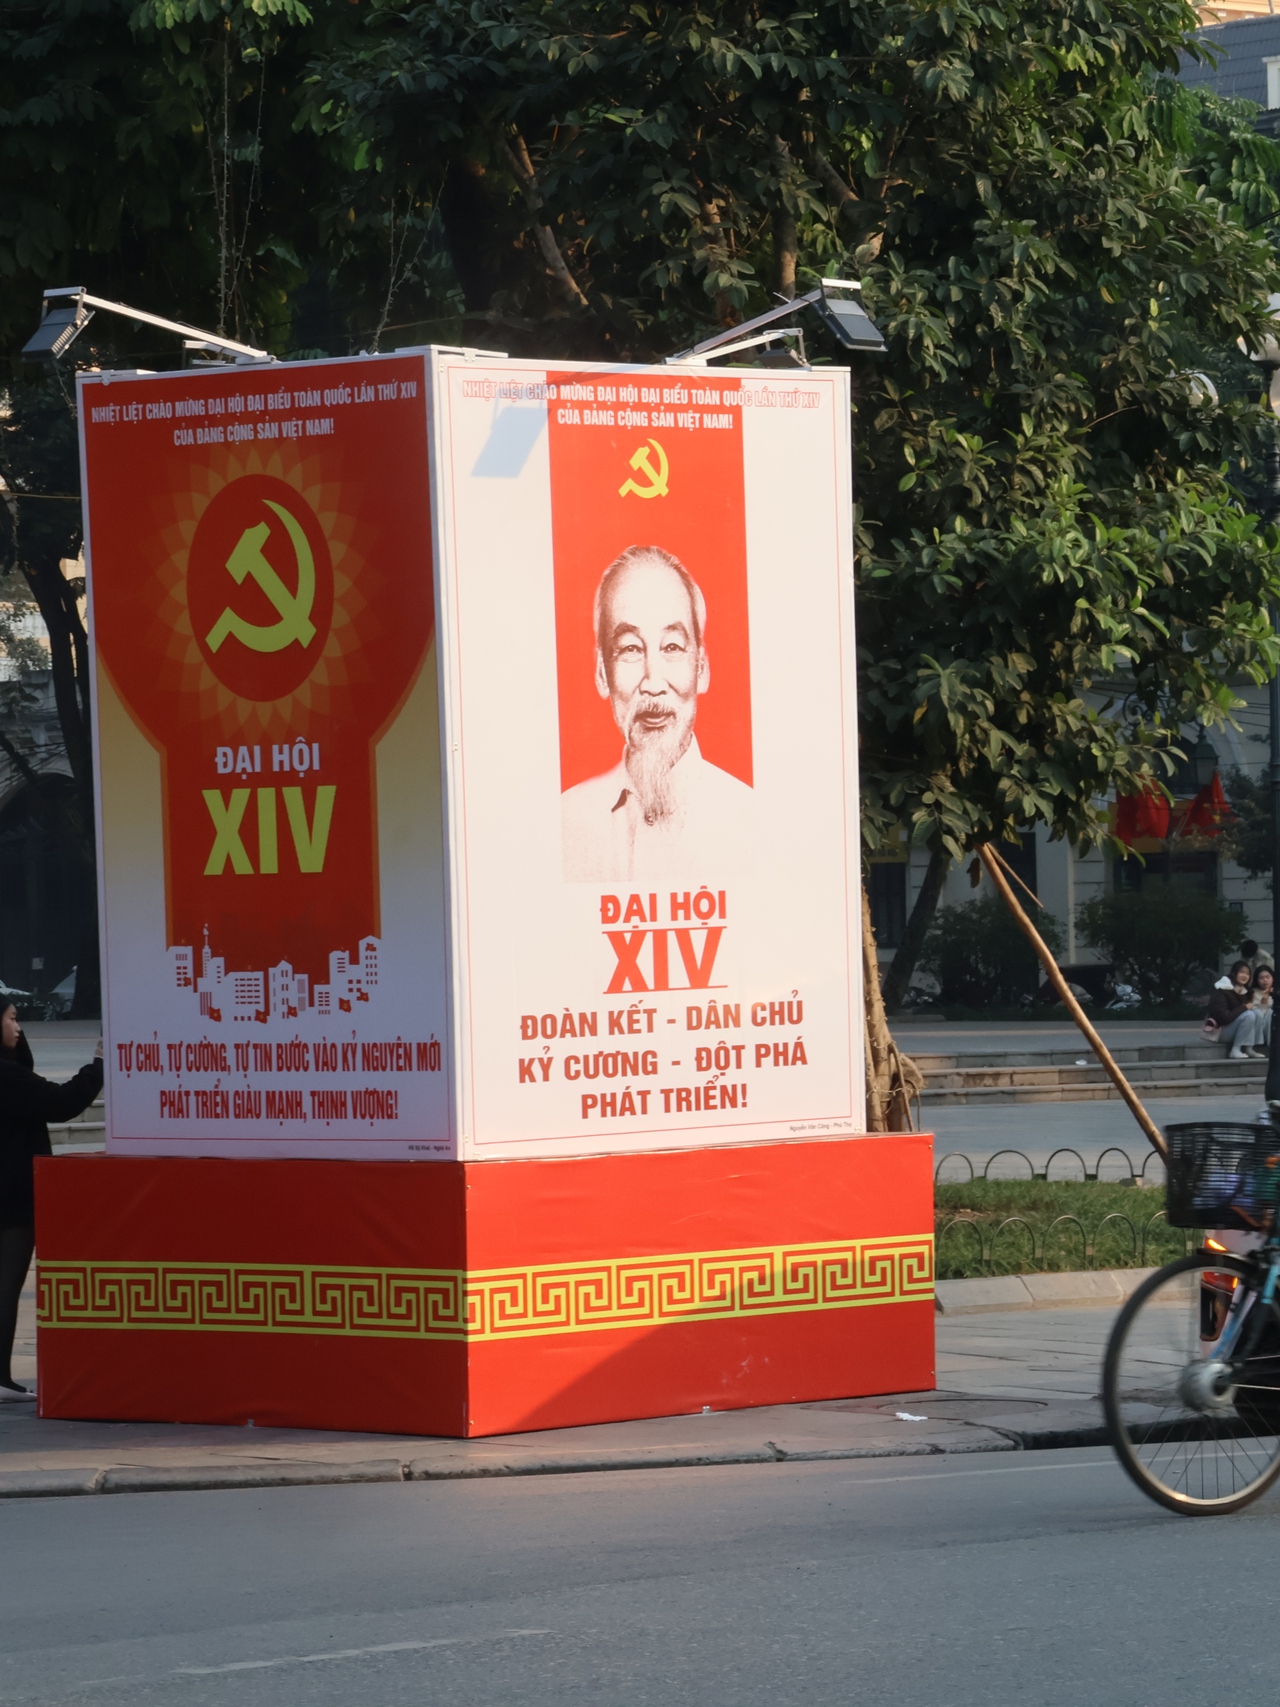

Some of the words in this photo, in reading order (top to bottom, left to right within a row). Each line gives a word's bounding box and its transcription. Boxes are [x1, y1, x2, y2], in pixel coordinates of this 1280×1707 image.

[91, 403, 119, 425] NHIỆT
[123, 401, 143, 424] LIỆT
[146, 400, 172, 420] CHÀO
[175, 396, 205, 417] MỪNG
[208, 398, 225, 418] ĐẠI
[228, 393, 244, 416] HỘI
[247, 394, 264, 415] ĐẠI
[267, 386, 291, 410] BIỂU
[293, 388, 321, 408] TOÀN
[323, 382, 351, 407] QUỐC
[377, 378, 398, 401] THỨ
[400, 381, 417, 399] XIV
[462, 378, 497, 401] NHIỆT
[499, 379, 524, 402] LIỆT
[525, 380, 557, 400] CHÀO
[560, 381, 594, 401] MỪNG
[597, 386, 616, 405] ĐẠI
[619, 384, 638, 406] HỘI
[641, 387, 660, 406] ĐẠI
[663, 383, 688, 404] BIỂU
[691, 387, 720, 405] TOÀN
[723, 385, 752, 407] QUỐC
[801, 391, 820, 408] XIV
[173, 422, 195, 446] CỦA
[196, 421, 225, 444] ĐẢNG
[227, 422, 254, 445] CỘNG
[257, 416, 279, 440] SẢN
[281, 418, 303, 440] VIỆT
[306, 418, 335, 436] NAM!
[557, 403, 581, 425] CỦA
[583, 404, 615, 426] ĐẢNG
[617, 408, 648, 430] CỘNG
[651, 405, 674, 427] SẢN
[677, 410, 700, 431] VIỆT
[703, 413, 733, 429] NAM!
[215, 745, 262, 780] ĐẠI
[272, 736, 320, 777] HỘI
[202, 785, 337, 875] XIV
[600, 893, 657, 929] ĐẠI
[670, 885, 727, 926] HỘI
[602, 926, 728, 995] XIV
[520, 1007, 598, 1040] ĐOÀN
[608, 999, 657, 1035] KẾT
[686, 999, 741, 1031] DÂN
[751, 989, 803, 1027] CHỦ
[117, 1041, 133, 1078] TỰ
[136, 1031, 164, 1076] CHỦ,
[167, 1041, 183, 1078] TỰ
[186, 1035, 231, 1076] CƯỜNG,
[234, 1040, 251, 1078] TỰ
[252, 1043, 273, 1072] TIN
[276, 1034, 309, 1072] BƯỚC
[313, 1036, 338, 1072] VÀO
[342, 1030, 358, 1072] KỶ
[361, 1036, 413, 1072] NGUYÊN
[416, 1033, 441, 1072] MỚI
[518, 1045, 554, 1084] KỶ
[564, 1050, 658, 1081] CƯƠNG
[695, 1040, 746, 1076] ĐỘT
[755, 1036, 808, 1068] PHÁ
[160, 1084, 191, 1119] PHÁT
[194, 1078, 230, 1119] TRIỂN
[233, 1084, 261, 1119] GIÀU
[265, 1090, 307, 1126] MẠNH,
[310, 1090, 347, 1126] THỊNH
[351, 1087, 398, 1127] VƯỢNG!
[581, 1085, 651, 1119] PHÁT
[660, 1075, 747, 1113] TRIỂN!
